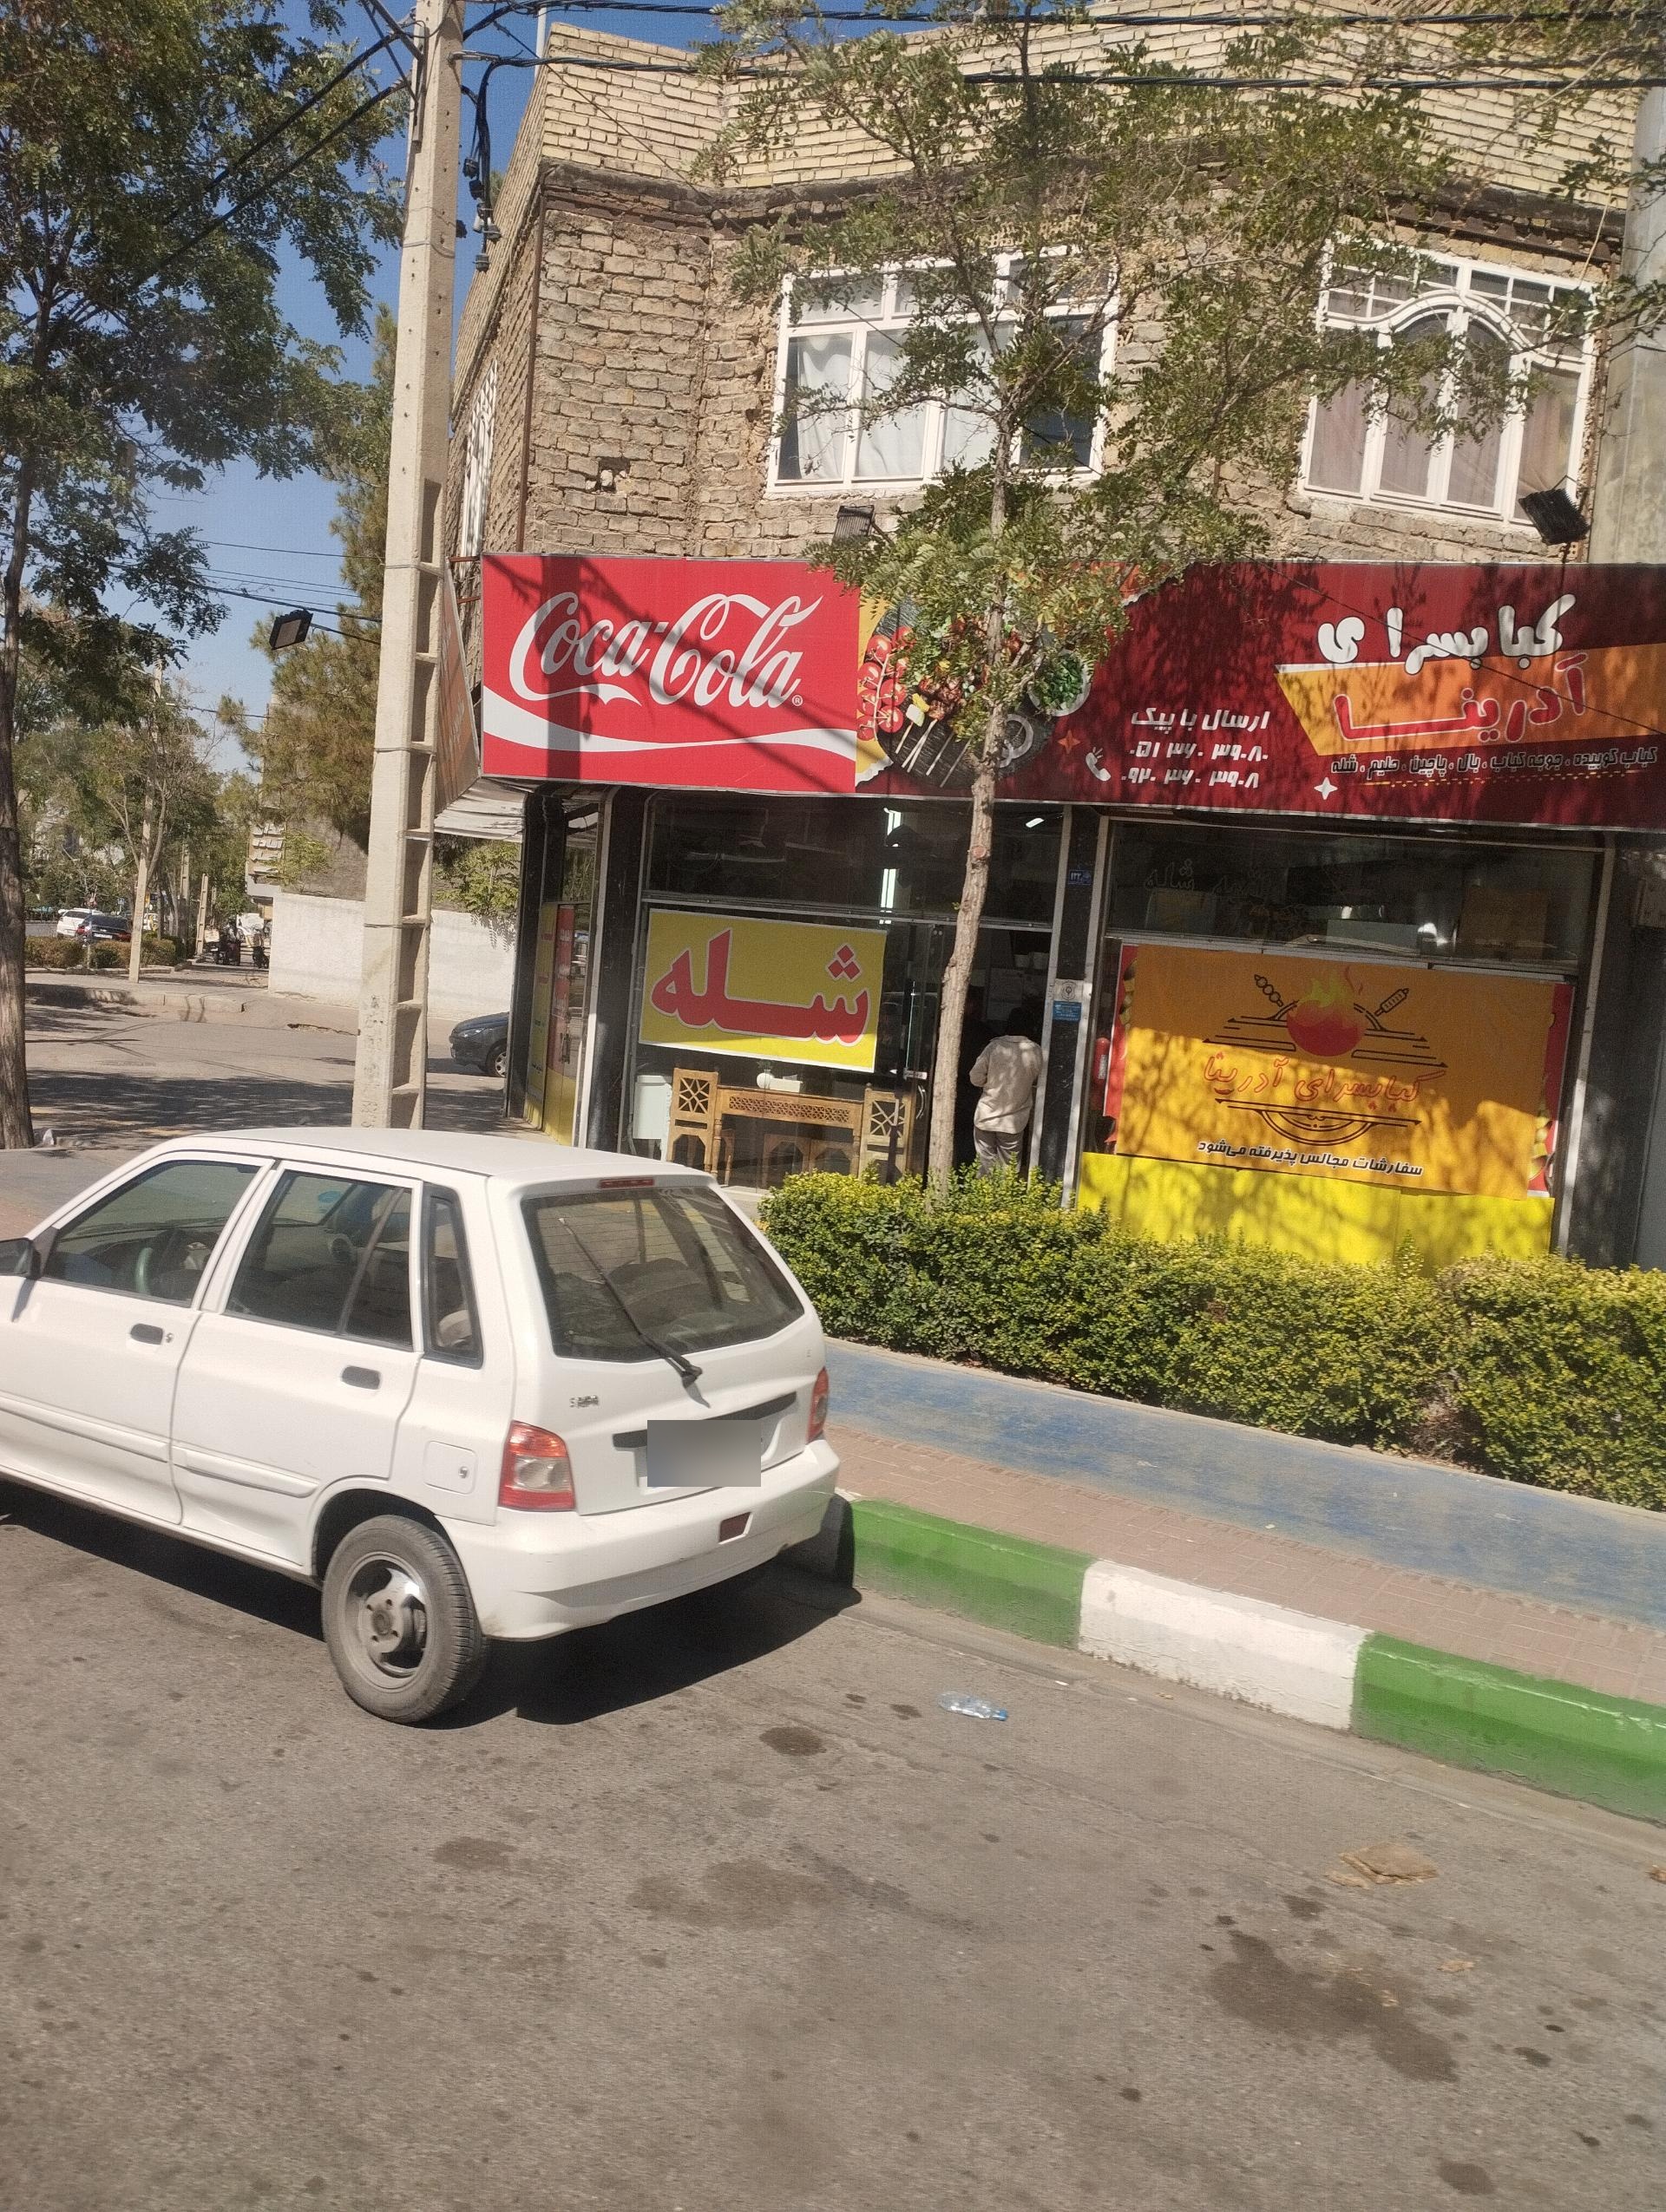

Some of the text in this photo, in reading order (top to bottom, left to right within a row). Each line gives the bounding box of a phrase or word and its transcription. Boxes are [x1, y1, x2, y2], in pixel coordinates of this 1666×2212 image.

[508, 592, 823, 709] Coca-Cola
[1334, 652, 1588, 743] آدرینا
[1131, 707, 1271, 735] ارسال با پیک
[1331, 753, 1359, 774] شله
[1527, 754, 1563, 772] جوجه
[1620, 747, 1657, 769] کباب
[651, 928, 869, 1046] شله
[1204, 1050, 1289, 1095] آدرینا
[1249, 1146, 1298, 1167] پذیرفته
[1298, 1151, 1349, 1169] مجالس
[1352, 1156, 1423, 1176] سفارشات
